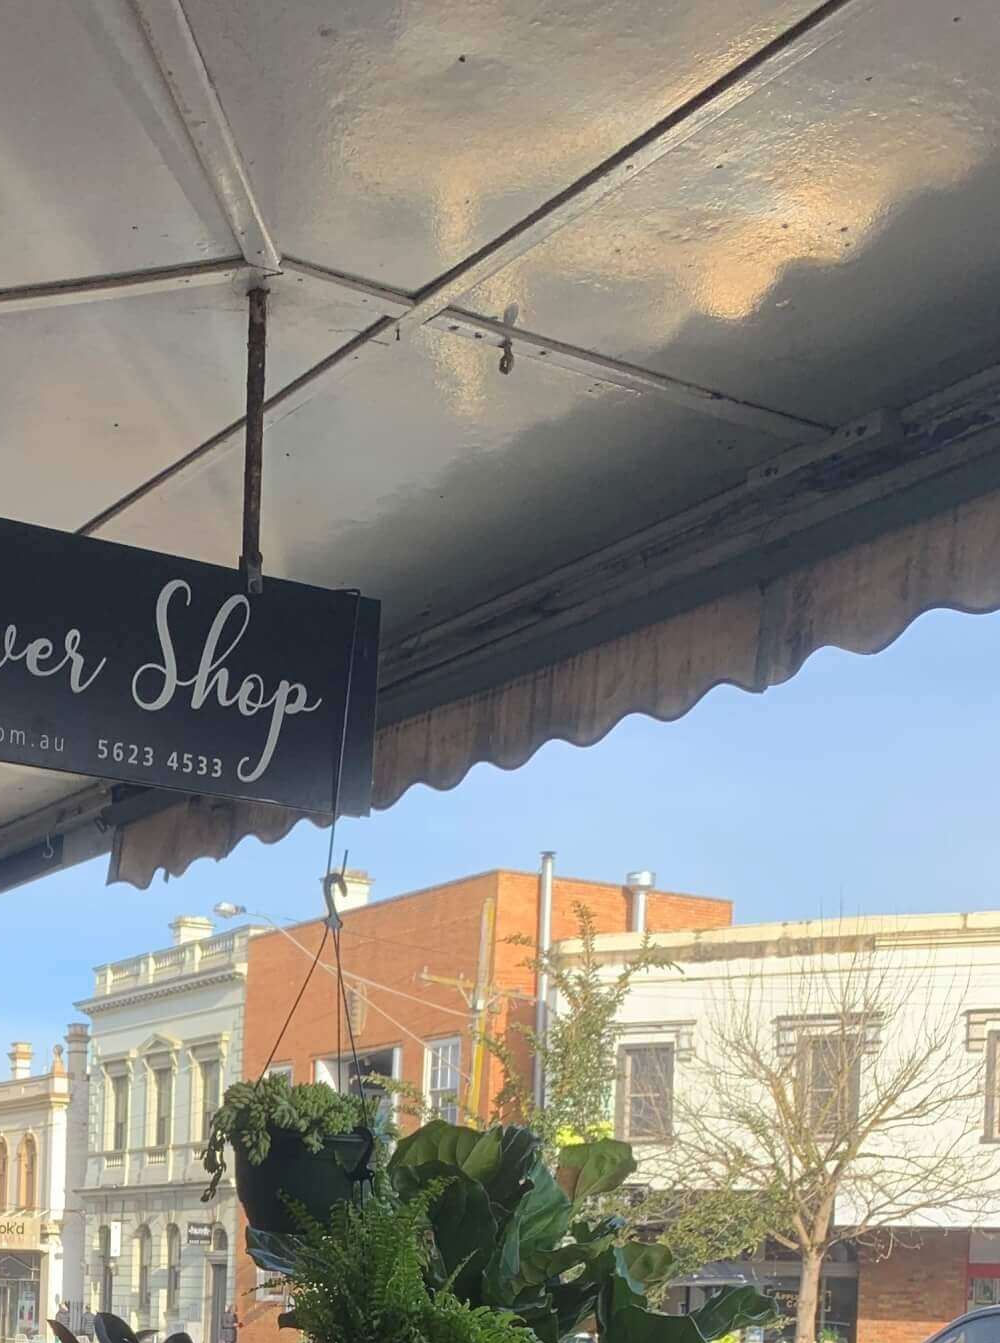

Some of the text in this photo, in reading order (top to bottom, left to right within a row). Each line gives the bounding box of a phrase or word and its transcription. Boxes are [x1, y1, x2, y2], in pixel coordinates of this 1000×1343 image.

[131, 579, 323, 784] Shop
[97, 738, 222, 778] 5623 4533
